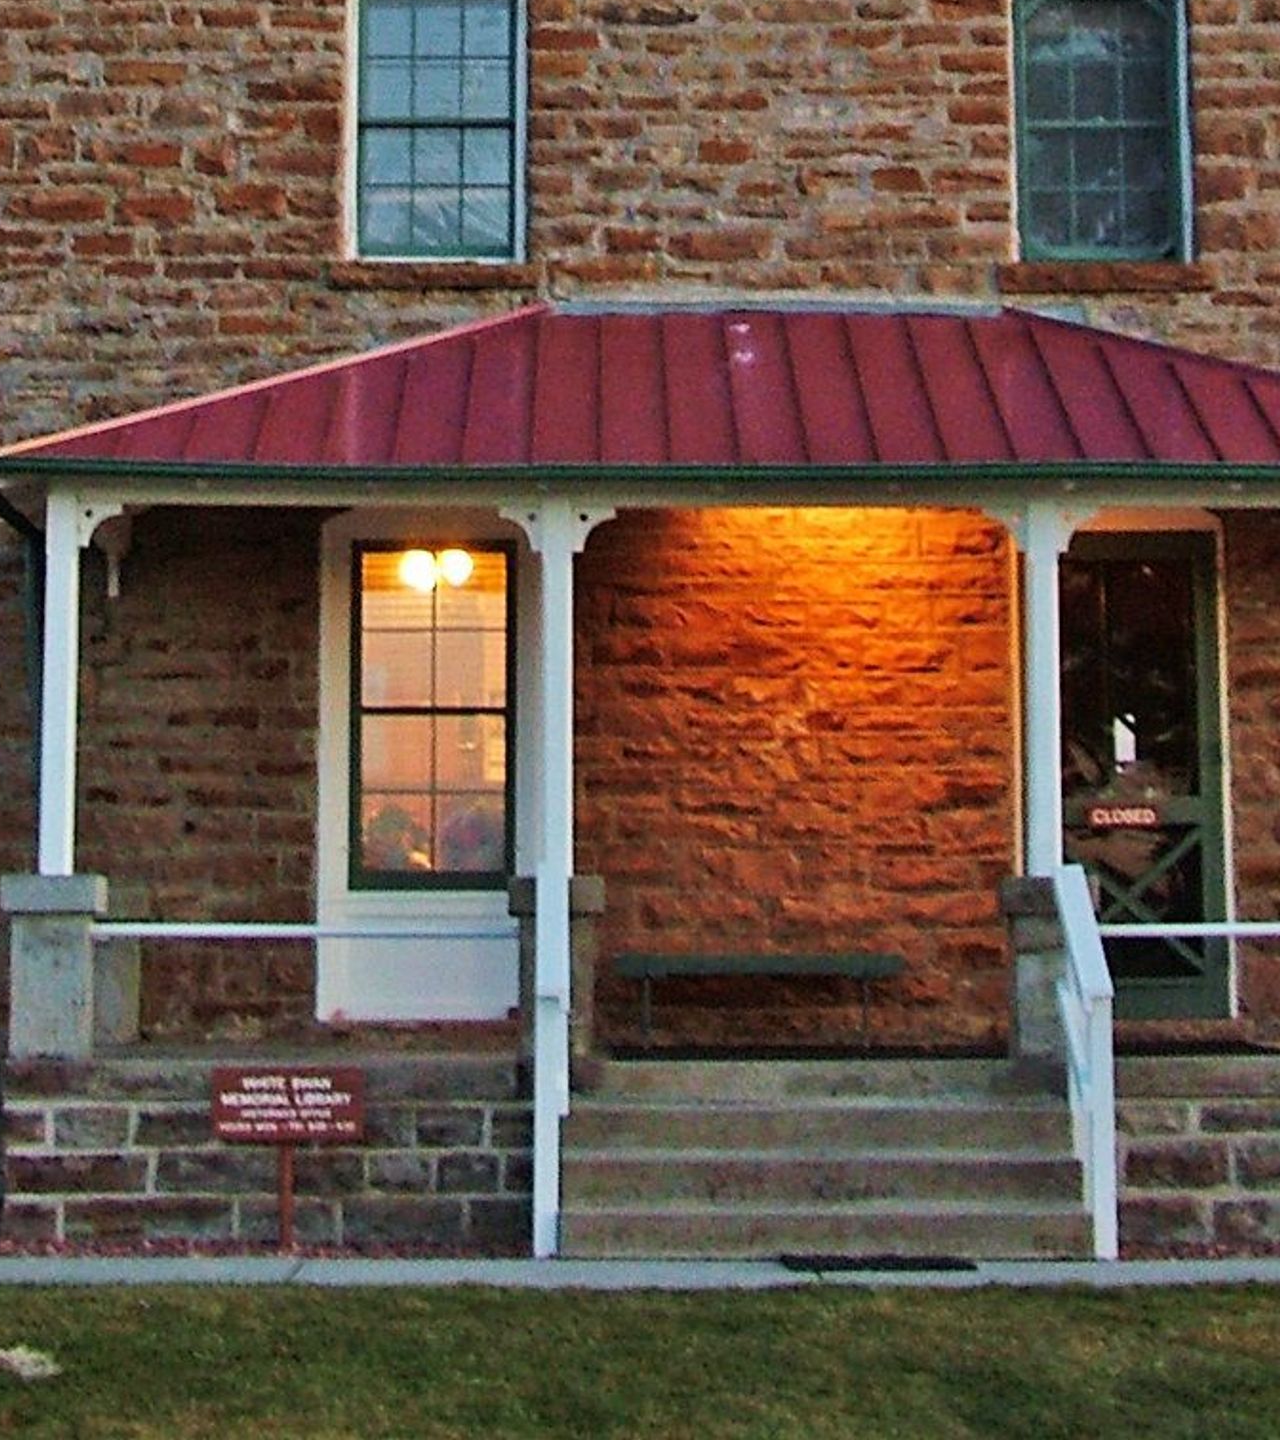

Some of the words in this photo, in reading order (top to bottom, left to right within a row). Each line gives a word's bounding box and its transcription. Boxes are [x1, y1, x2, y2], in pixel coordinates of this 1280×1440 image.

[1092, 809, 1155, 824] CLOSED
[242, 1076, 286, 1090] WHITE
[291, 1076, 331, 1090] SWAN
[220, 1092, 290, 1106] MEMORIAL
[294, 1092, 351, 1106] LIBRARY
